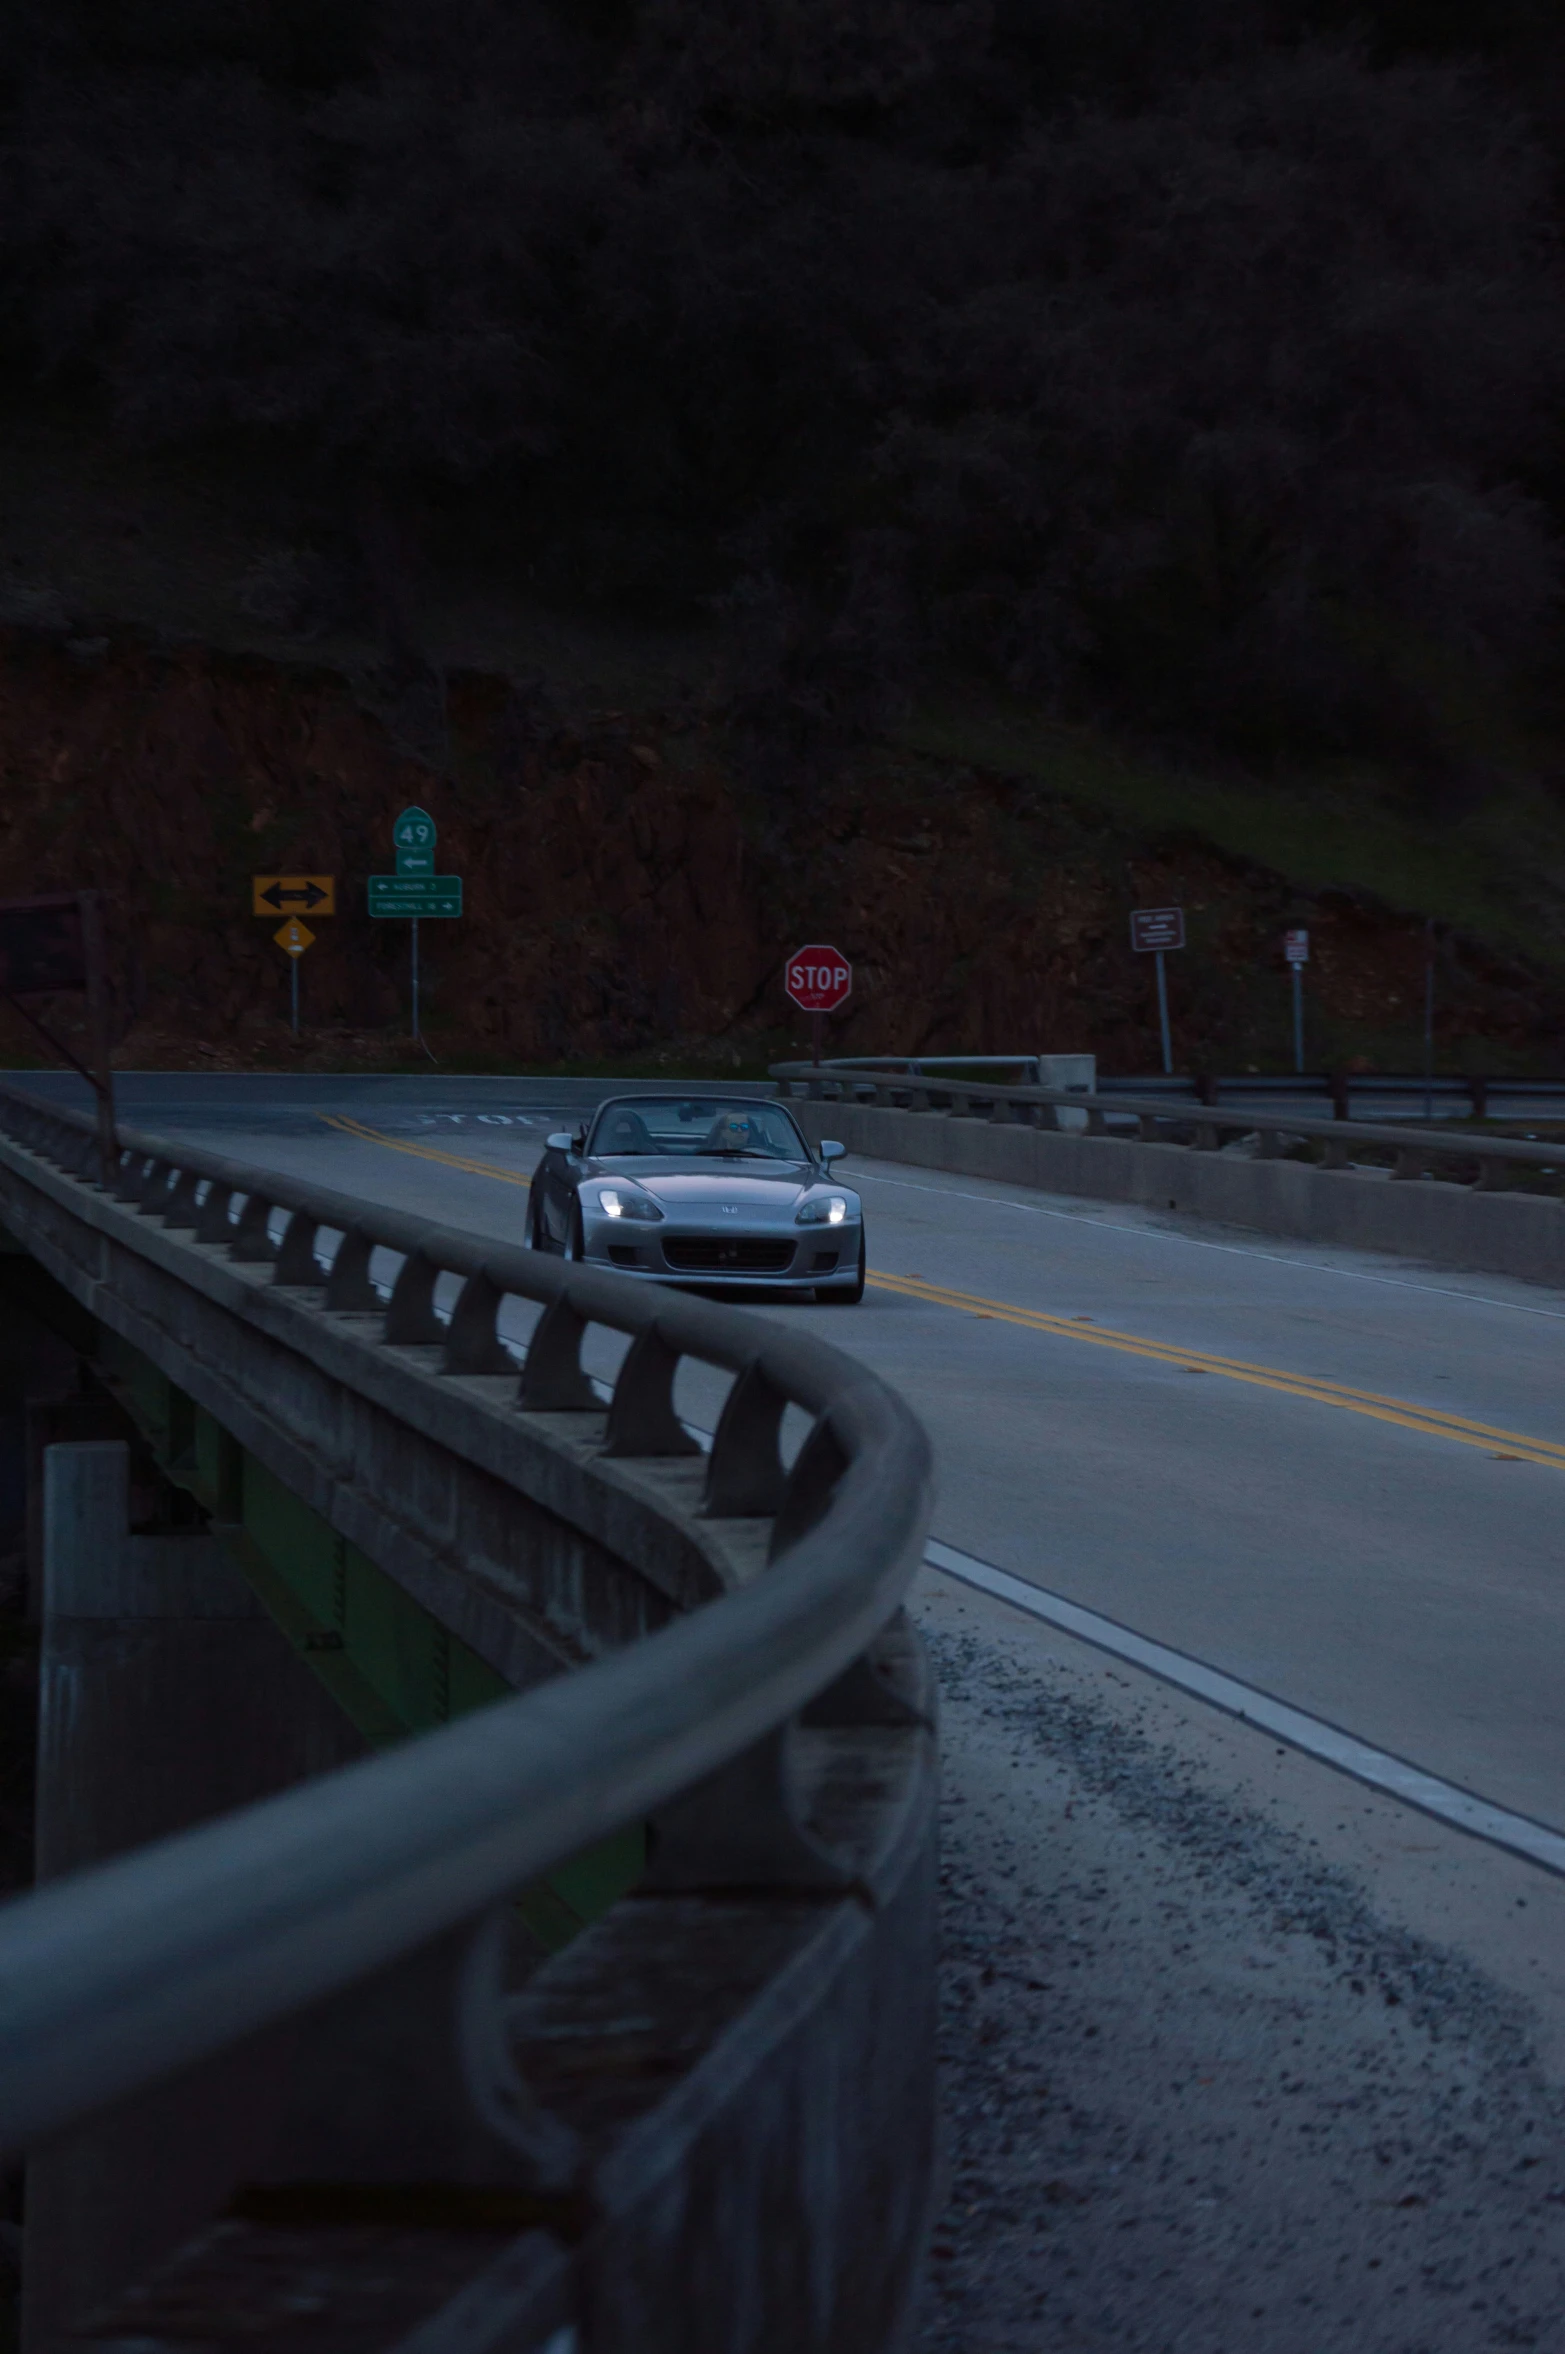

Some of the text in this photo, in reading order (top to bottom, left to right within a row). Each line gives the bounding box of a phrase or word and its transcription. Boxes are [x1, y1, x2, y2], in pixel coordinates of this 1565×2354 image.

[400, 825, 429, 843] 49
[790, 965, 848, 991] STOP
[404, 1113, 551, 1125] STOP
